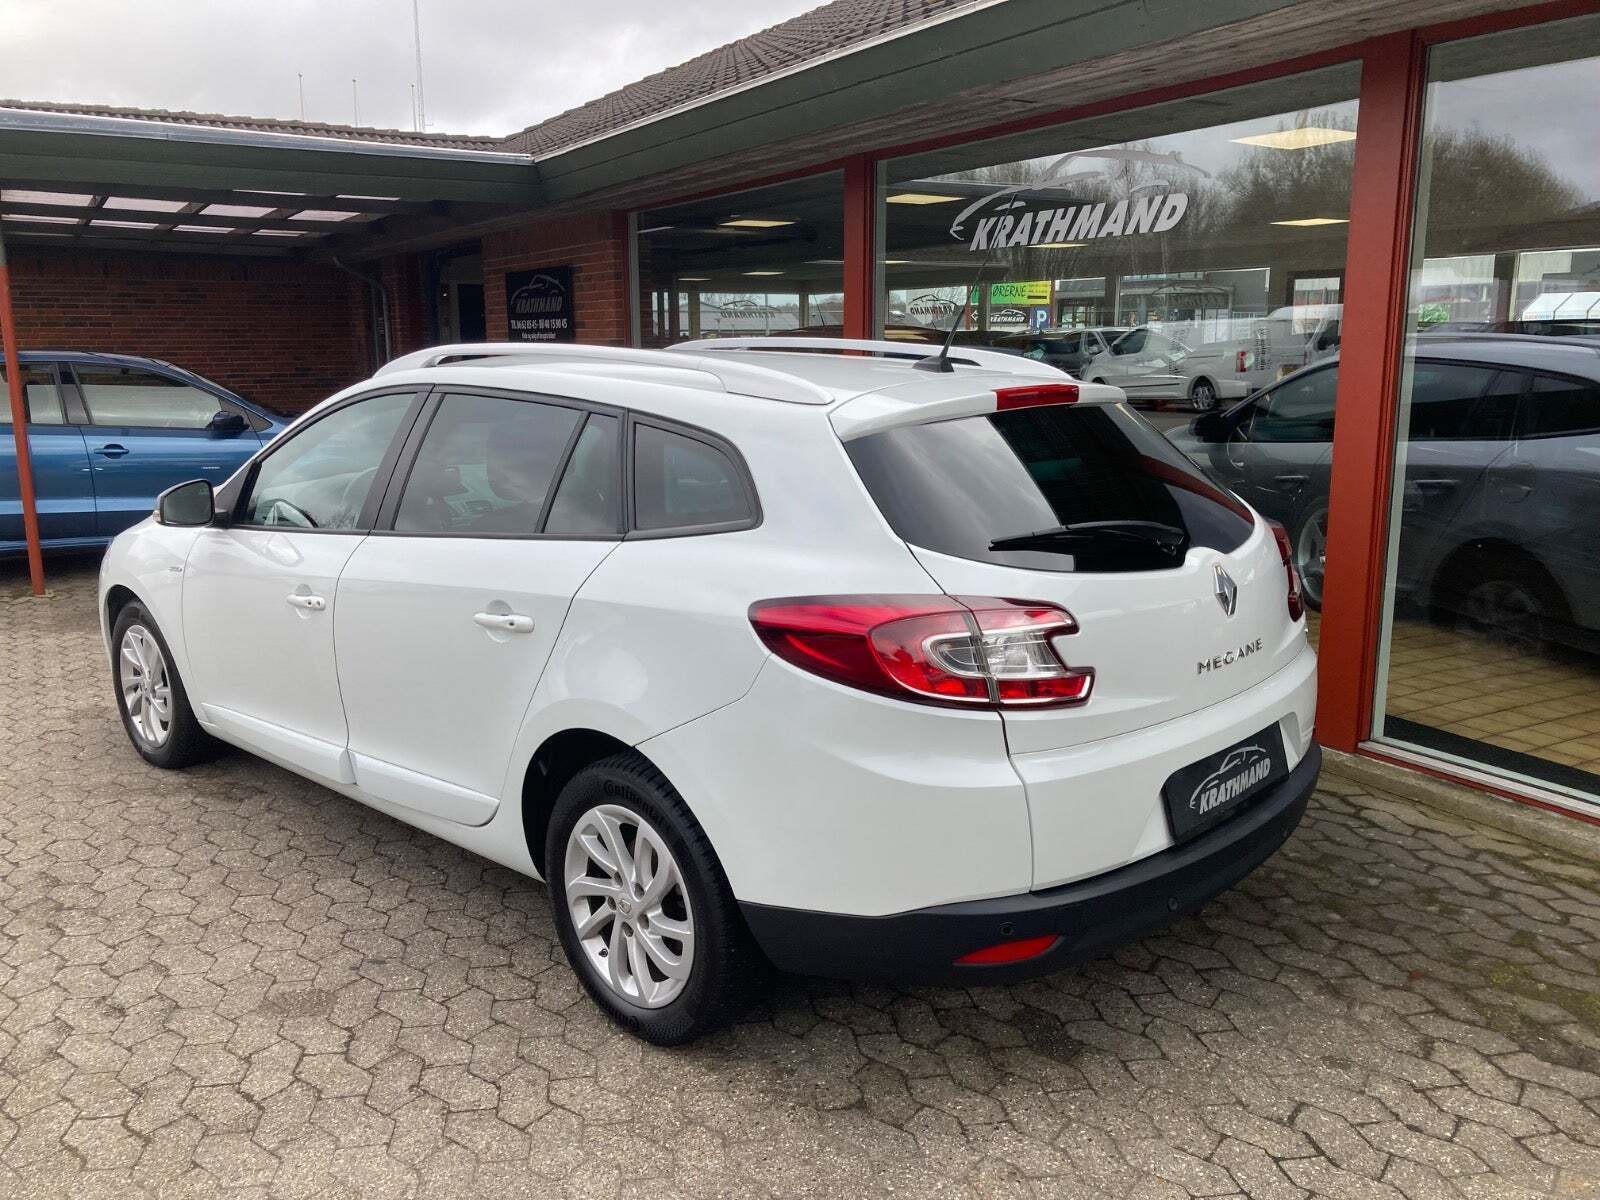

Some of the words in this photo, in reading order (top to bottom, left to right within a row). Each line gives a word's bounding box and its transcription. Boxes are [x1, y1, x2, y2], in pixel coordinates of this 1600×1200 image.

[969, 193, 1189, 252] KRATHMAND
[1036, 310, 1047, 328] P
[1197, 638, 1263, 675] MEGANE
[1200, 758, 1271, 814] KRATHMAND
